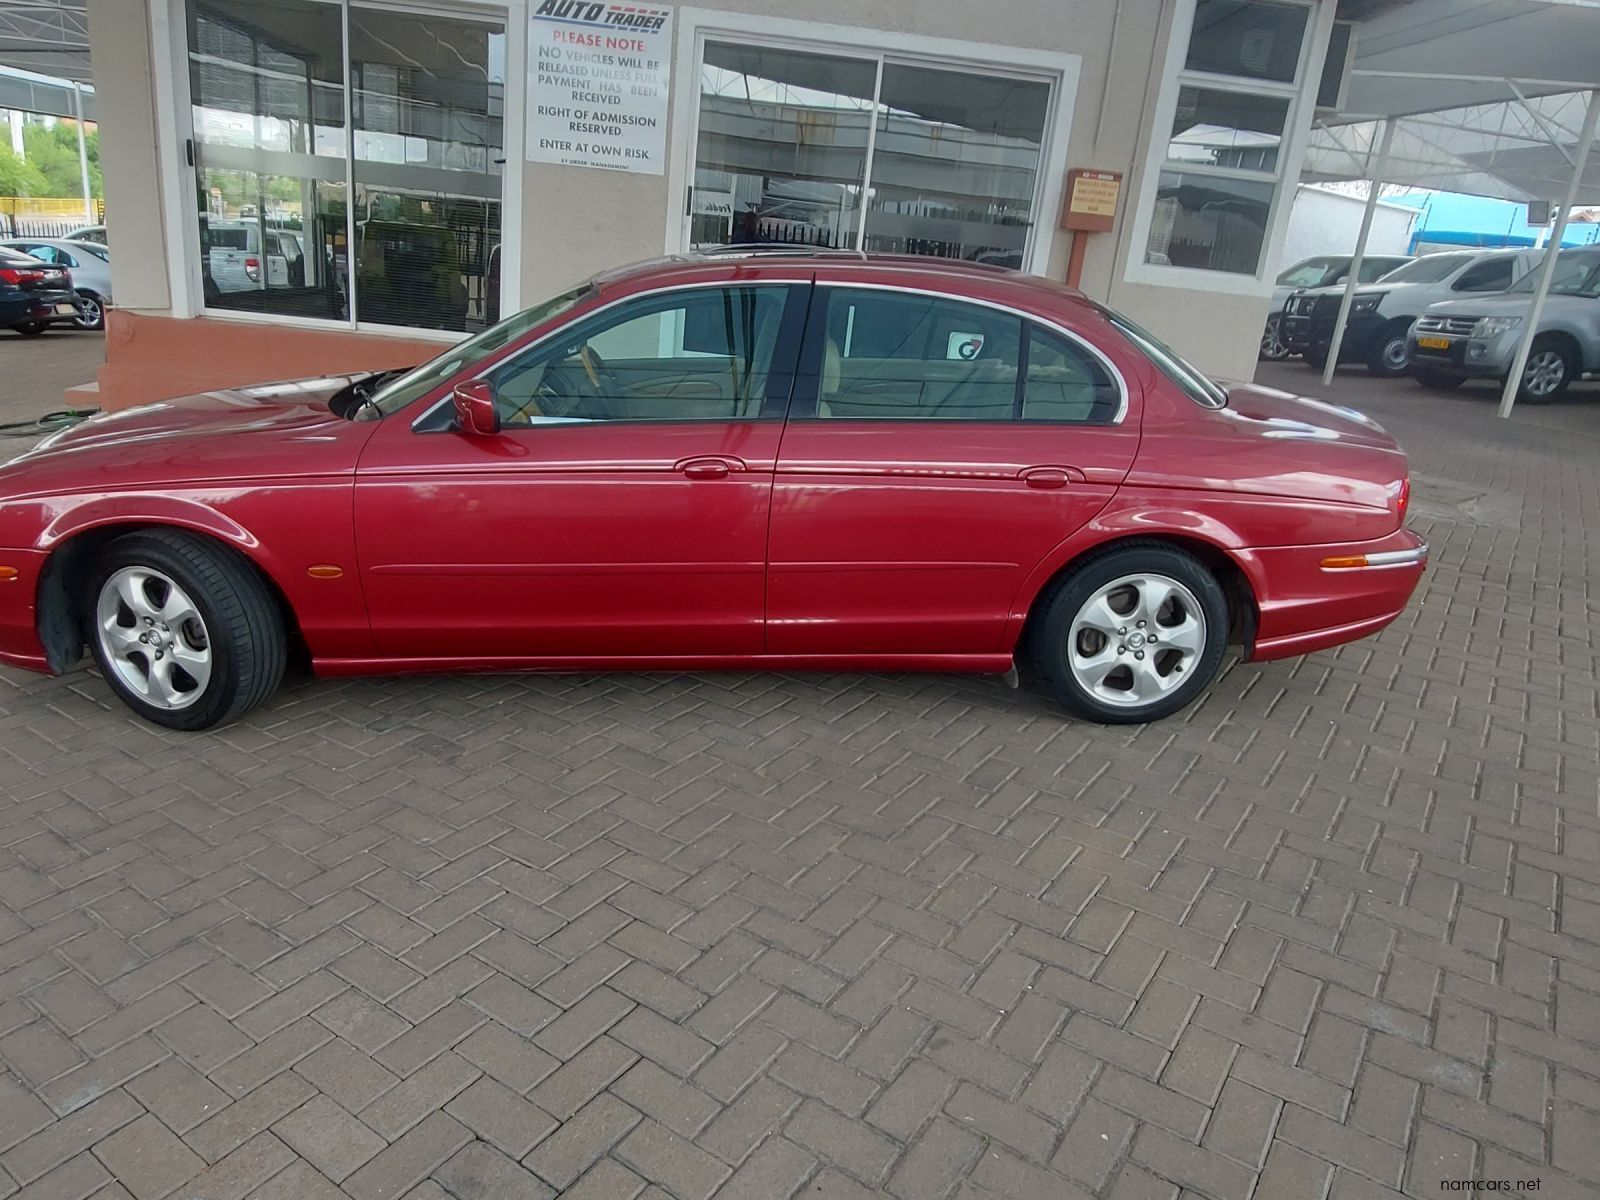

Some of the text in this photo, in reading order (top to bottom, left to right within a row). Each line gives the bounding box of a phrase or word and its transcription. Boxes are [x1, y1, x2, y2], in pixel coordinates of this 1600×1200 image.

[536, 0, 666, 29] AUTO TRADER
[553, 29, 647, 53] PLEASE NOTE:
[538, 45, 660, 70] NO VEHICLES WILL BE
[538, 61, 658, 84] RELEASED UNLESS FULL
[538, 74, 657, 97] PAYMENT HAS BEEN
[537, 105, 656, 127] RIGHT OF ADMISSION
[539, 138, 572, 151] ENTER
[575, 142, 589, 153] AT
[591, 144, 622, 156] OWN
[590, 161, 629, 170] MANAGEMENT
